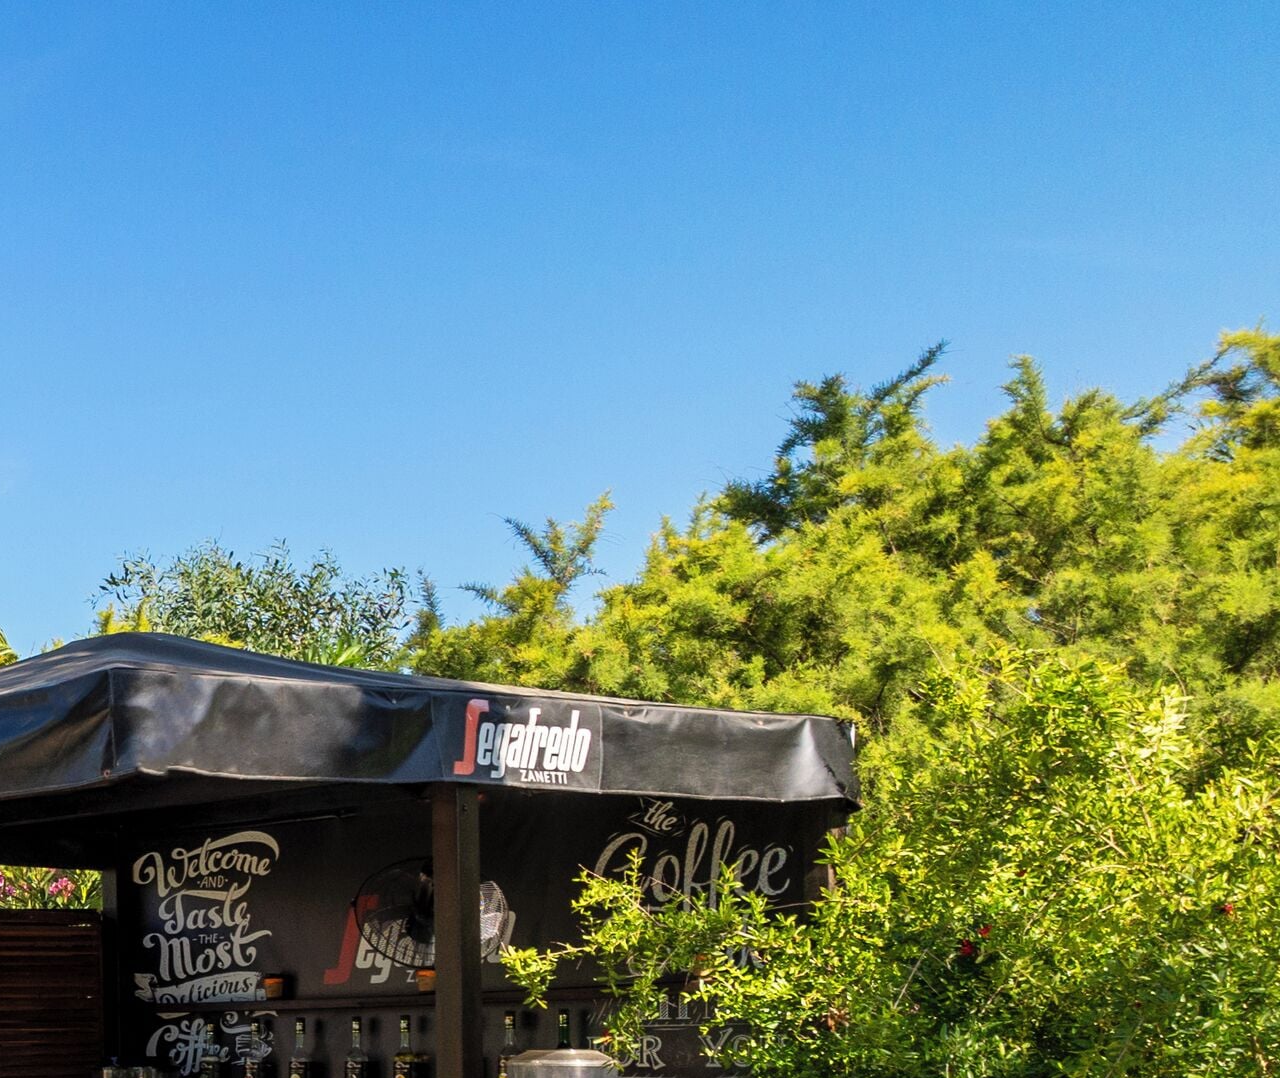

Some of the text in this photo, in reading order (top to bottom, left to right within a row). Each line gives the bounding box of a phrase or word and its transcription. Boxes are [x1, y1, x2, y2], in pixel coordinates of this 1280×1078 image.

[453, 699, 591, 778] Segafredo
[519, 770, 568, 785] ZANETTI
[643, 801, 678, 831] the
[133, 831, 280, 897] Welcome
[199, 876, 226, 888] AND
[159, 876, 251, 935] Taste
[143, 914, 272, 981] Most
[198, 933, 219, 944] THE
